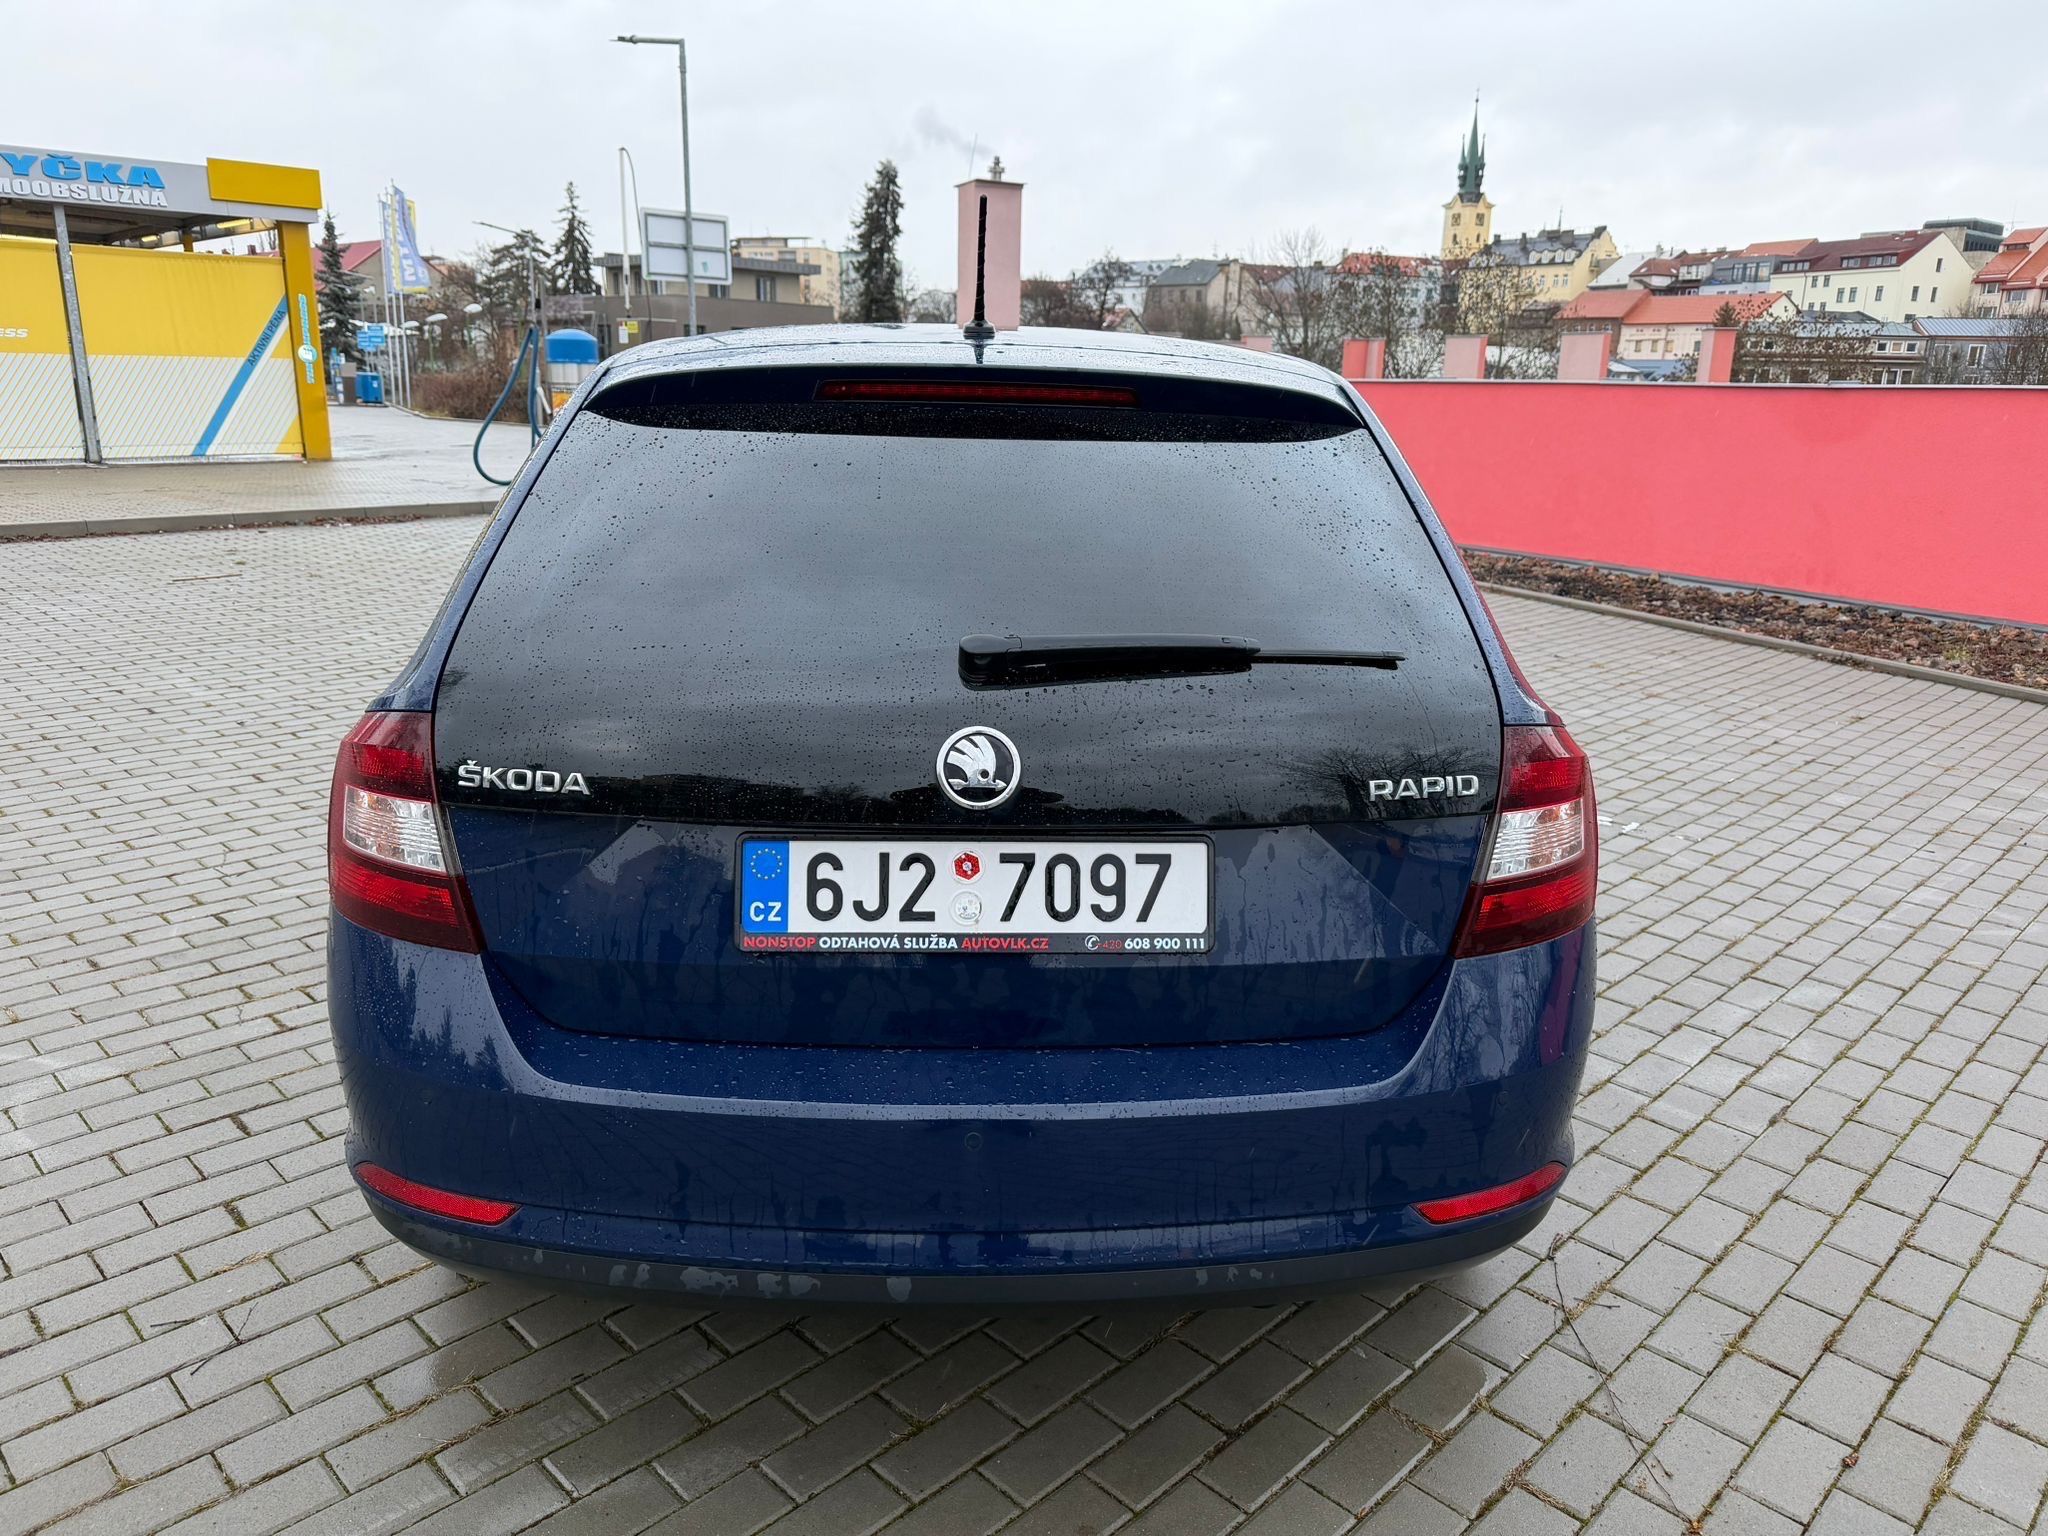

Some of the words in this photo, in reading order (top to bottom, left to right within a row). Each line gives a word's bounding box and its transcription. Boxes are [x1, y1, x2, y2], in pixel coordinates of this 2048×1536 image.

[0, 151, 166, 189] YČKA
[457, 759, 591, 796] ŠKODA
[1368, 774, 1480, 802] RAPID
[805, 852, 936, 923] 6J2
[999, 852, 1172, 923] 7097
[749, 902, 782, 922] CZ
[743, 936, 816, 949] NONSTOP
[819, 935, 901, 949] ODTAHOVÁ
[903, 934, 958, 949] SLUŽBA
[961, 936, 1049, 949] AUTOVLK.CZ
[1124, 937, 1151, 949] 608
[1153, 937, 1181, 950] 900
[1184, 937, 1205, 950] 111
